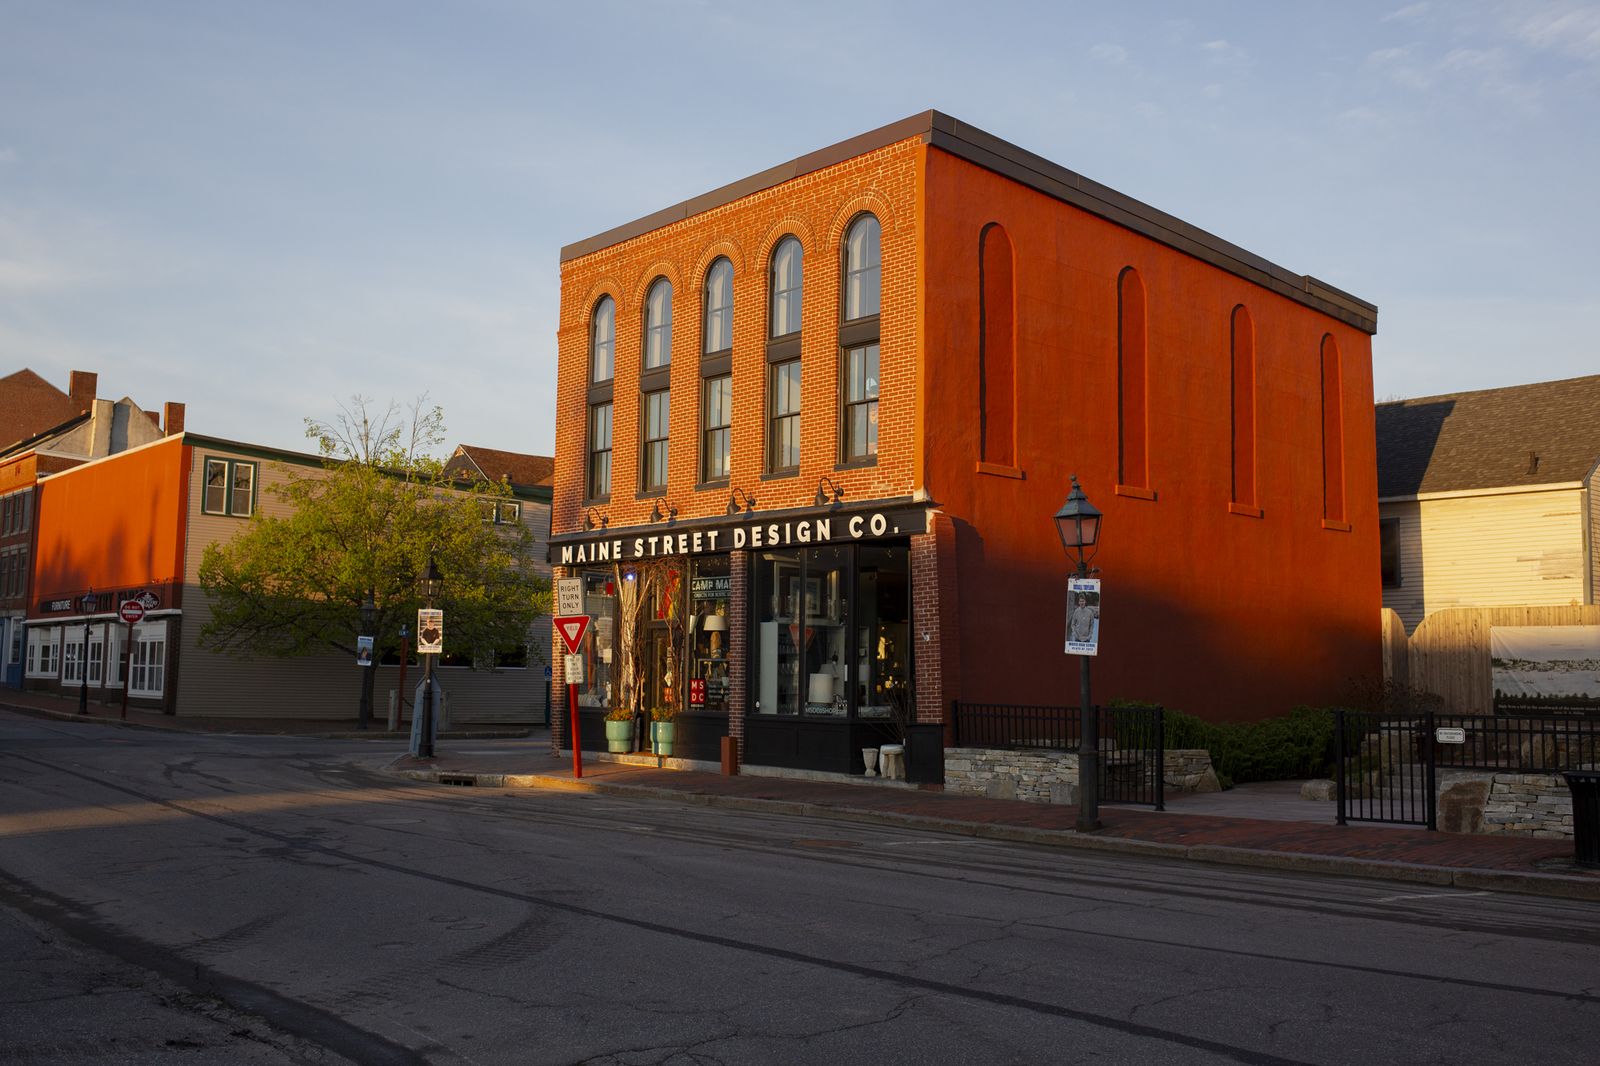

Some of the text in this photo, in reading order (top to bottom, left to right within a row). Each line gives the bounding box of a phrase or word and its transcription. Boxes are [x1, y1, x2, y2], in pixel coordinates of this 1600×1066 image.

[561, 513, 899, 564] MAINE STREET DESIGN CO.
